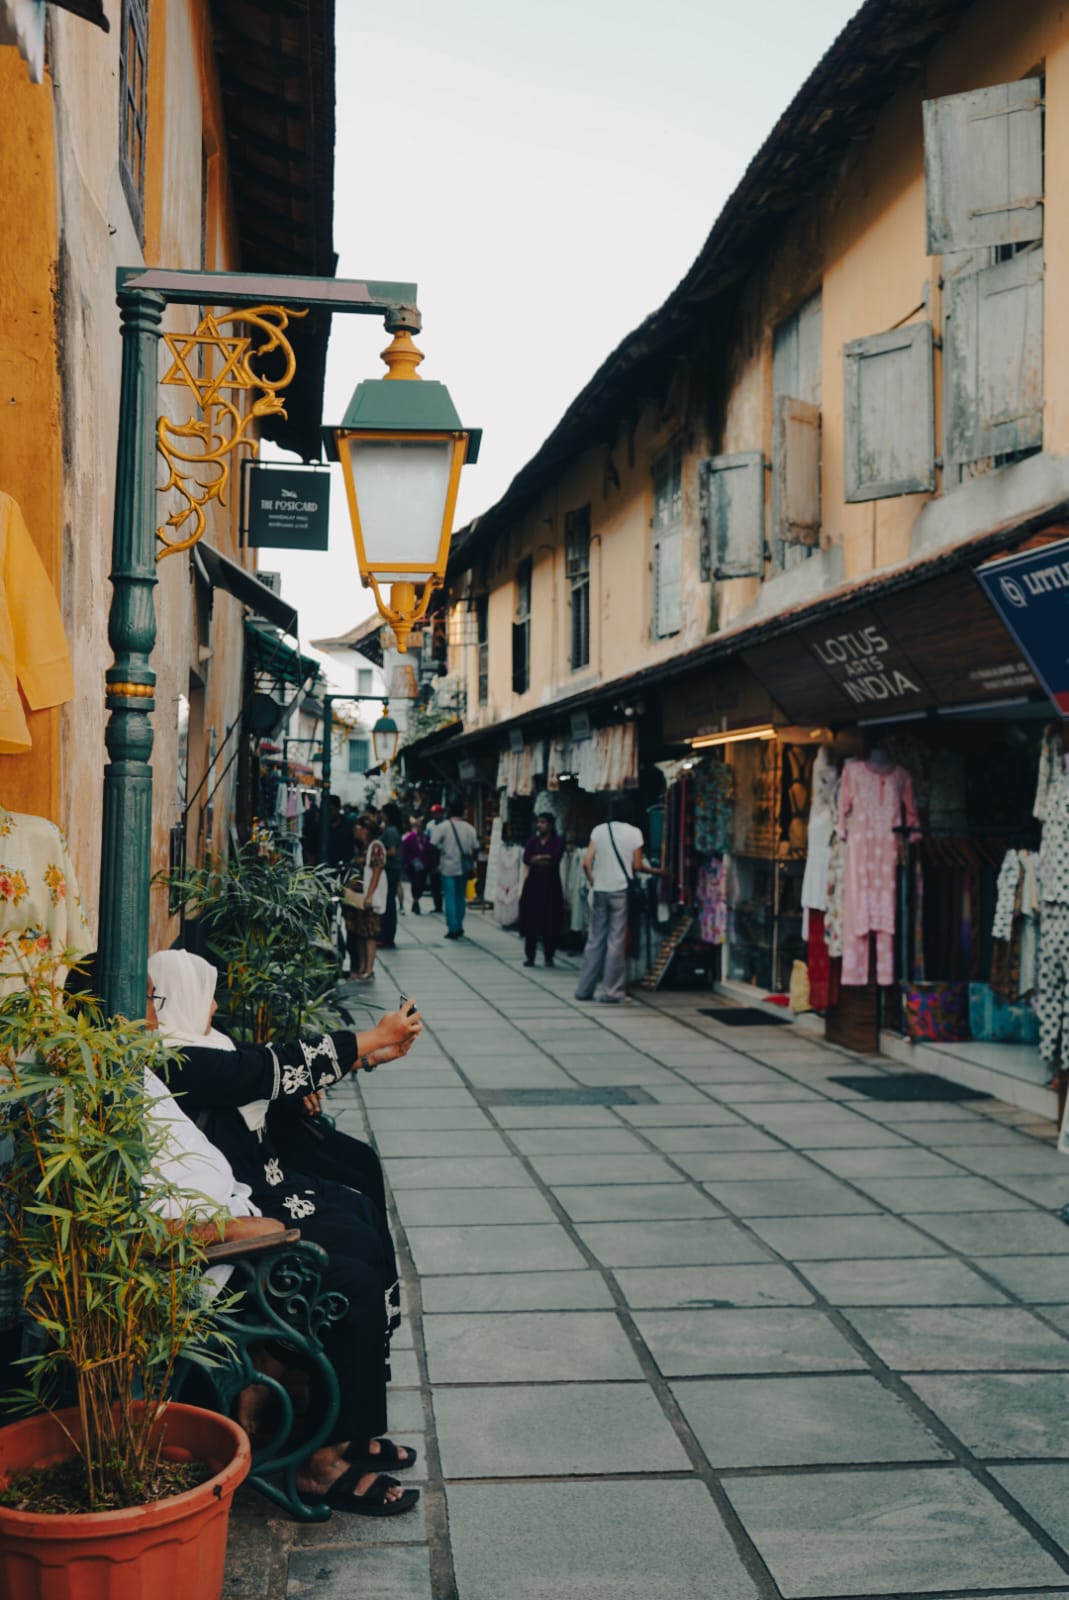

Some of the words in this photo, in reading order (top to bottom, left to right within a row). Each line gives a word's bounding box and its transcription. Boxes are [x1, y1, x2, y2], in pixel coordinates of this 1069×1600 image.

[275, 500, 318, 513] POSTCARD
[812, 626, 889, 664] LOTUS
[844, 655, 885, 677] ARTS
[842, 670, 920, 703] INDIA
